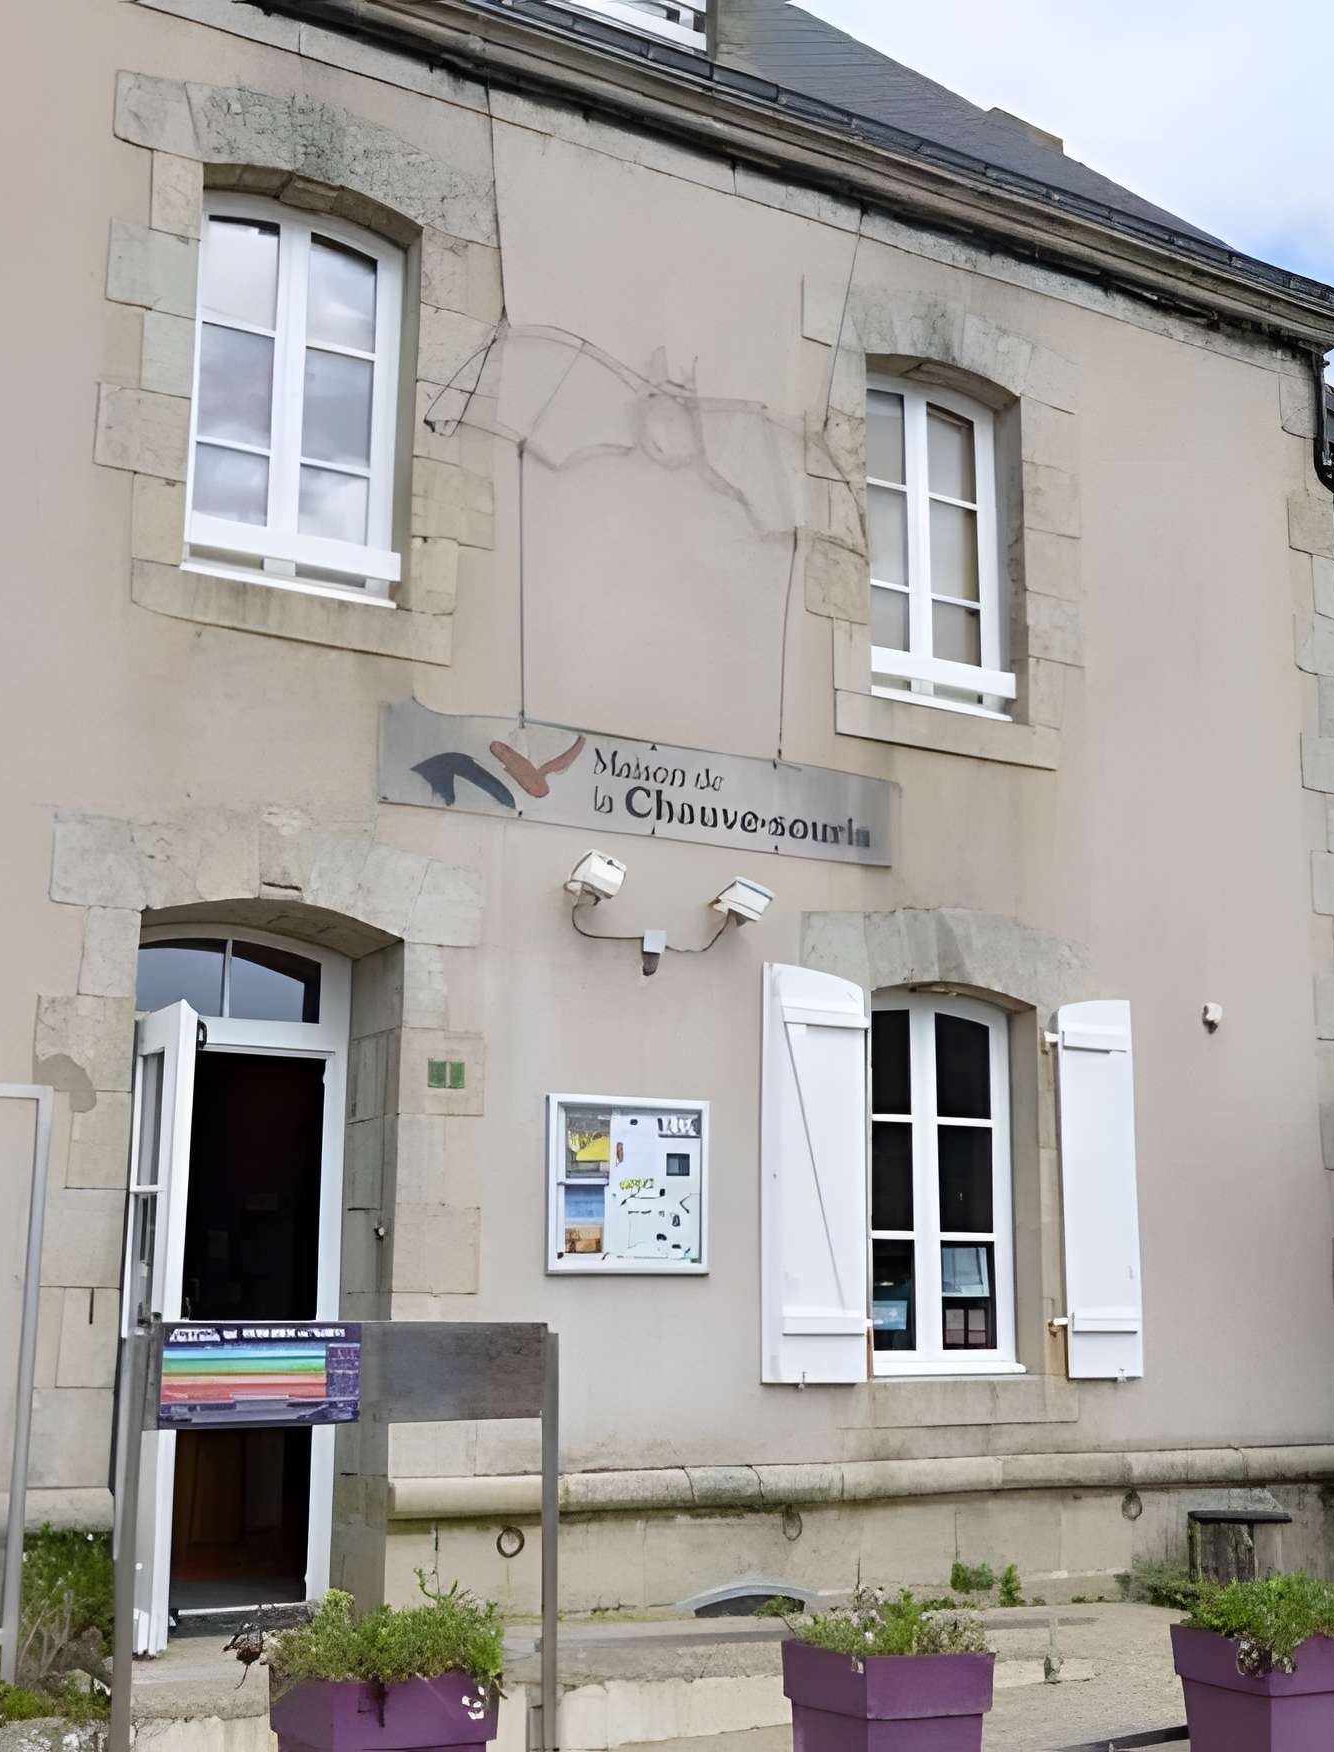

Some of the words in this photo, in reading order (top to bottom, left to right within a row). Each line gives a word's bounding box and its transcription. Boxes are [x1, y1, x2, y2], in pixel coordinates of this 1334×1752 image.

[593, 747, 686, 788] Maison
[695, 768, 725, 792] de
[593, 785, 614, 813] la
